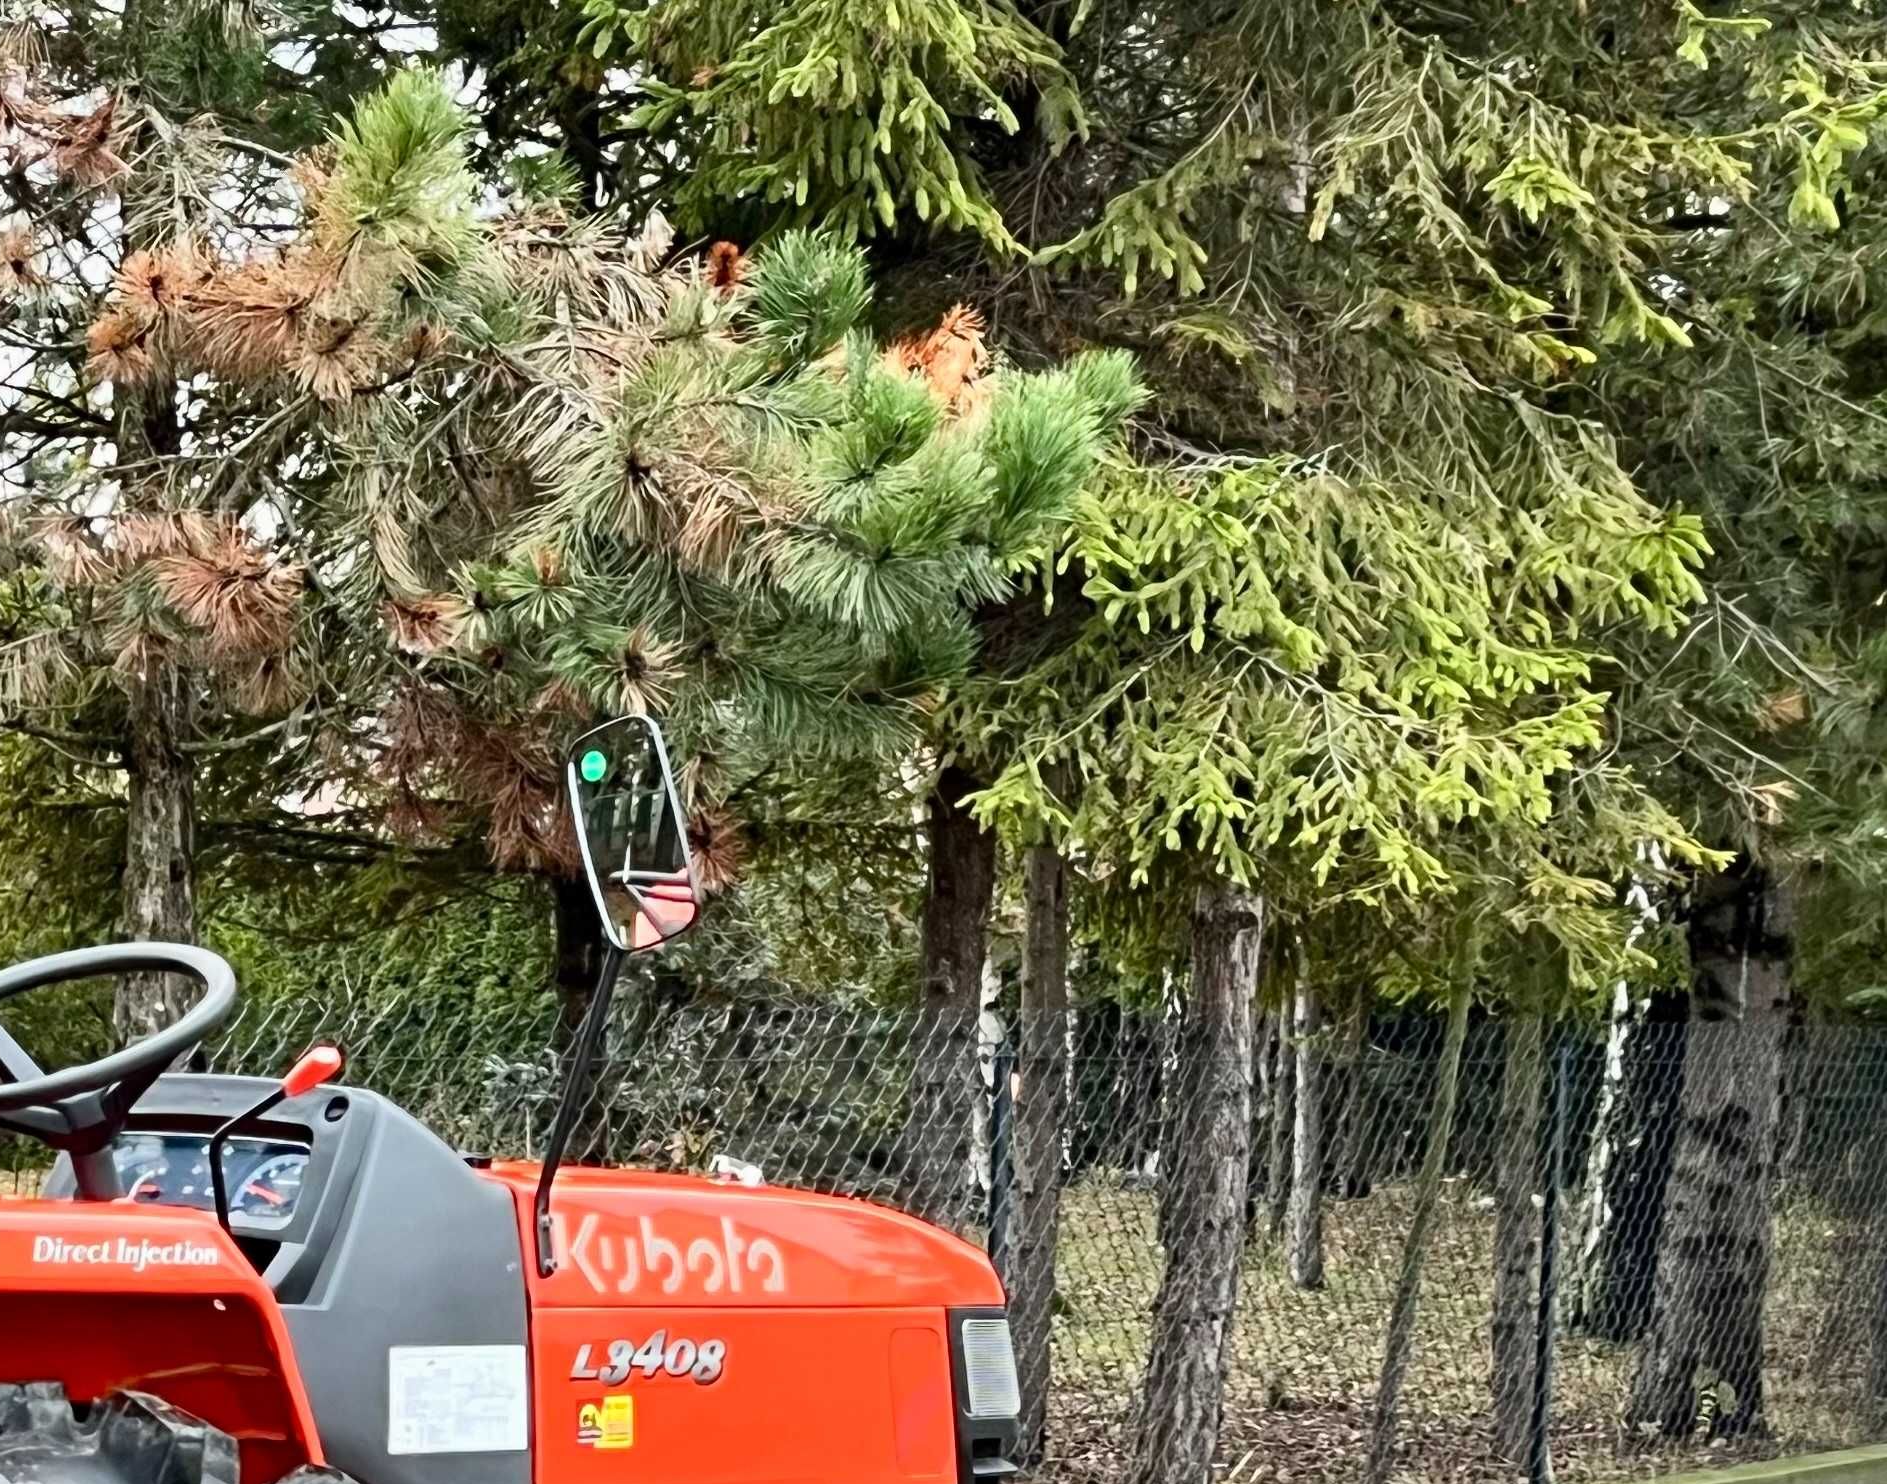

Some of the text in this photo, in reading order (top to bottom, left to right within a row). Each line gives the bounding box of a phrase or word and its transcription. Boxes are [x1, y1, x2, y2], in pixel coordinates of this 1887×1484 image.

[32, 1235, 220, 1273] Direct Injection
[550, 1212, 786, 1293] Kubota
